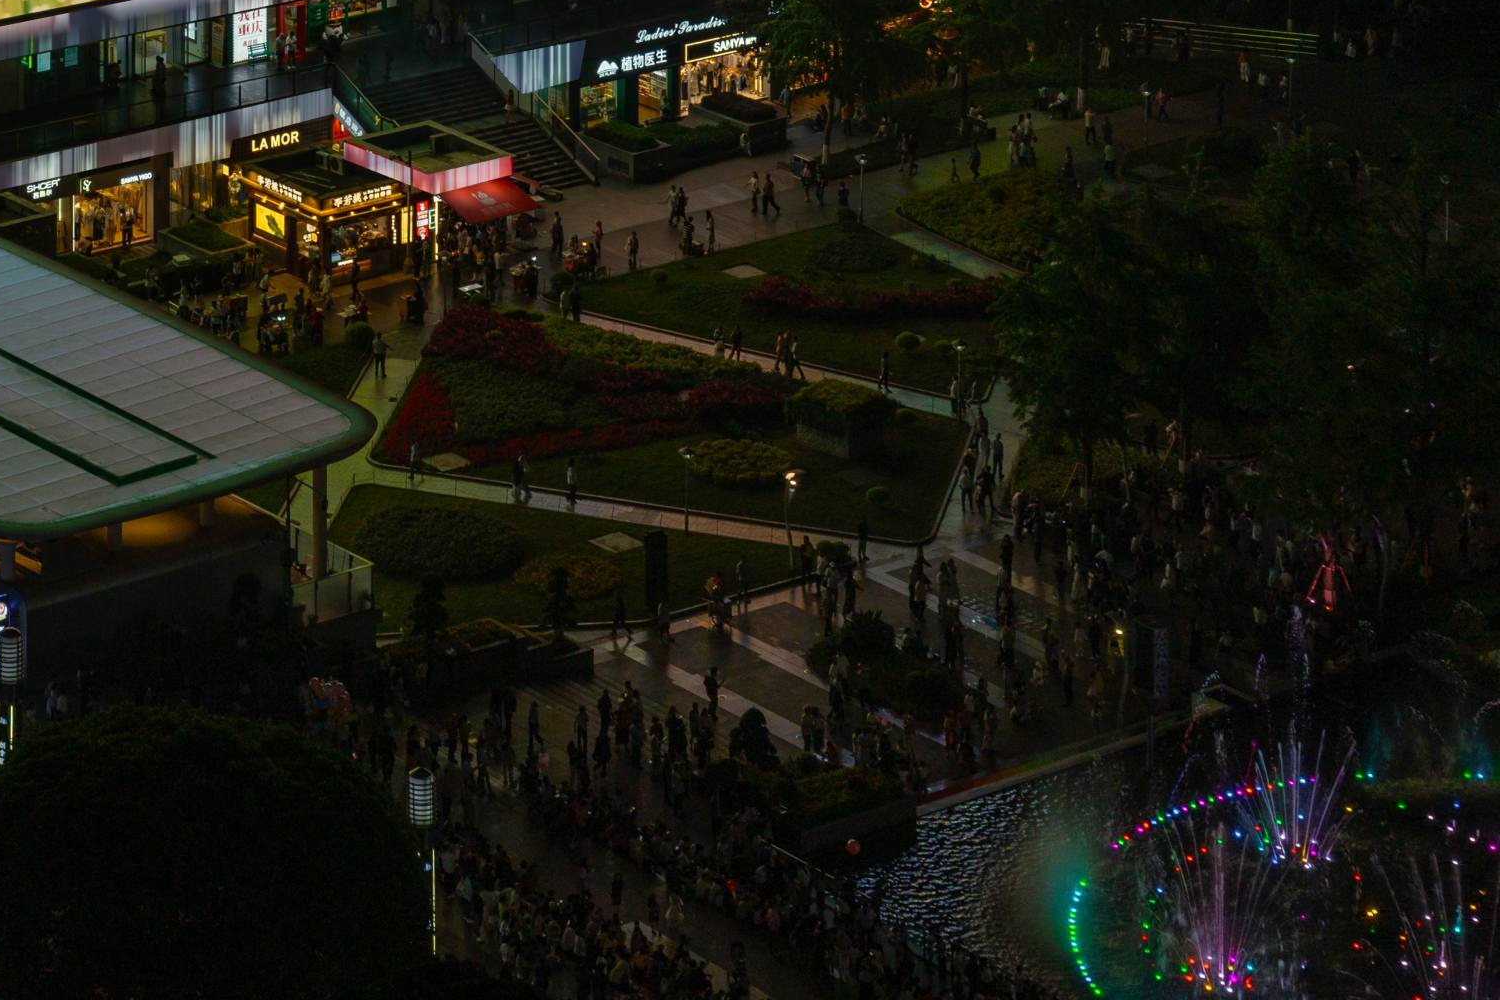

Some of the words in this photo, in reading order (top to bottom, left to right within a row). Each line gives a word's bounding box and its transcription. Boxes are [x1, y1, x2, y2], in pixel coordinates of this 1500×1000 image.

[237, 20, 263, 37] 重庆
[620, 48, 668, 72] 植物医生
